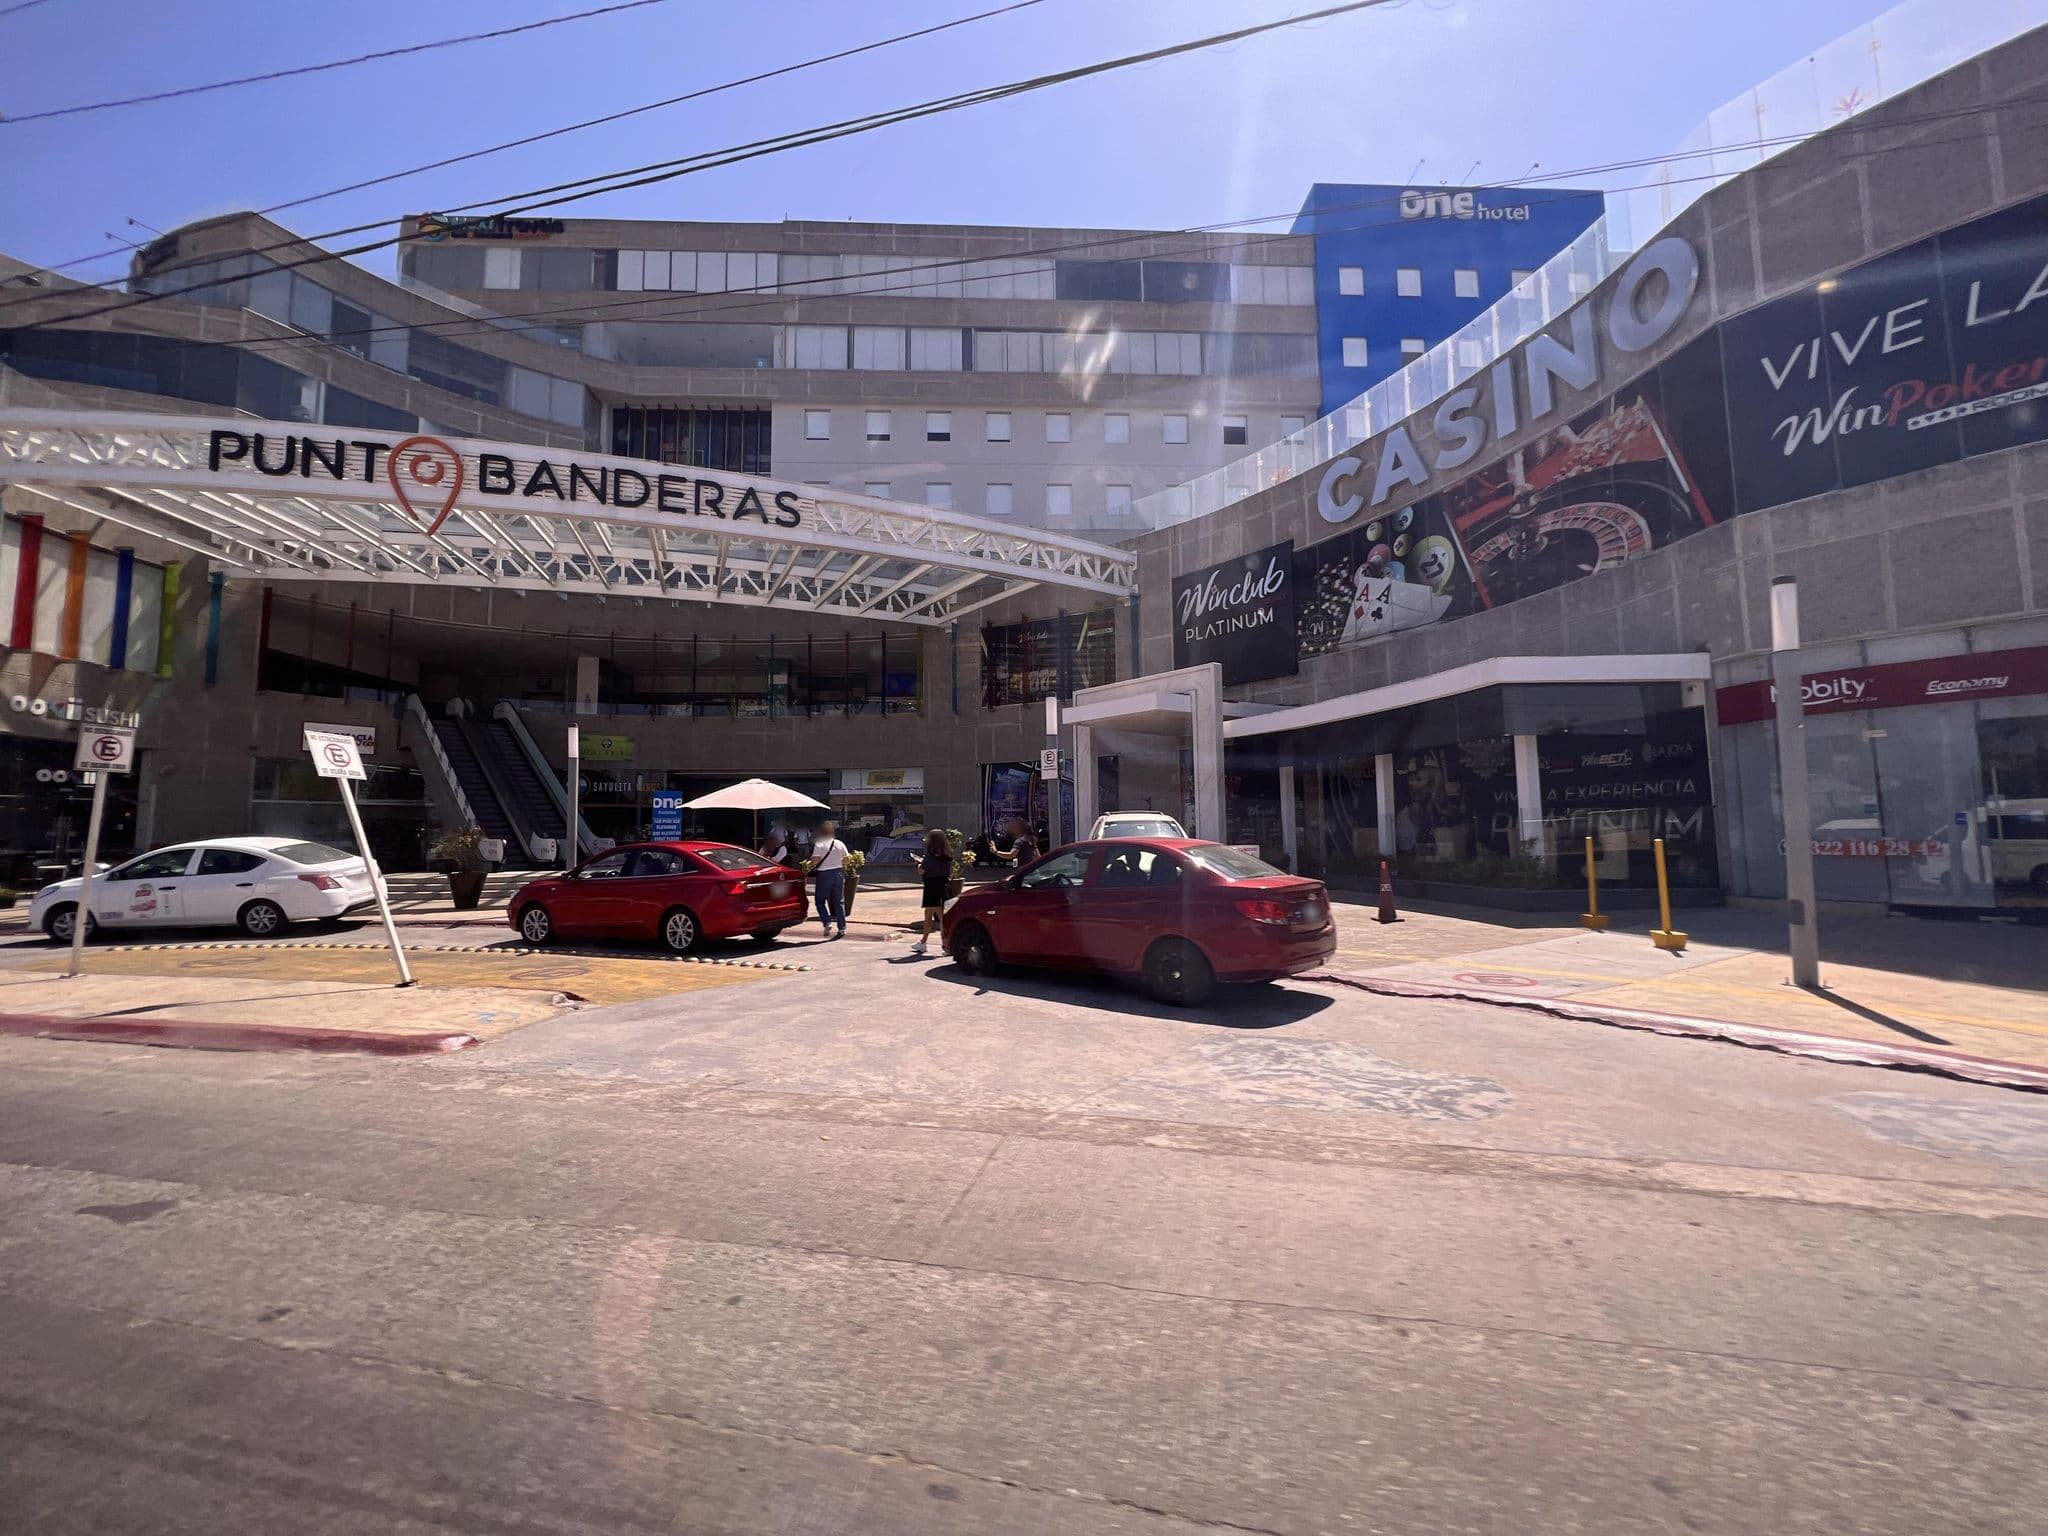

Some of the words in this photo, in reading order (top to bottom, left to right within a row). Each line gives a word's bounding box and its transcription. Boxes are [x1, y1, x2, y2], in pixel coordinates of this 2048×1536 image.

[1401, 190, 1474, 219] one
[1478, 203, 1529, 220] hotel
[1760, 298, 1929, 391] VIVE
[1317, 237, 1699, 524] CASINO
[479, 453, 801, 528] BANDERAS
[1177, 556, 1284, 626] Winclub
[1185, 607, 1273, 643] PLATINUM
[1927, 676, 2009, 692] Economy
[84, 706, 139, 728] SUSHI
[593, 782, 632, 792] SAYULITA
[1565, 778, 1696, 800] EXPERIENCIA
[1811, 839, 1844, 856] 322
[1849, 839, 1879, 856] 116
